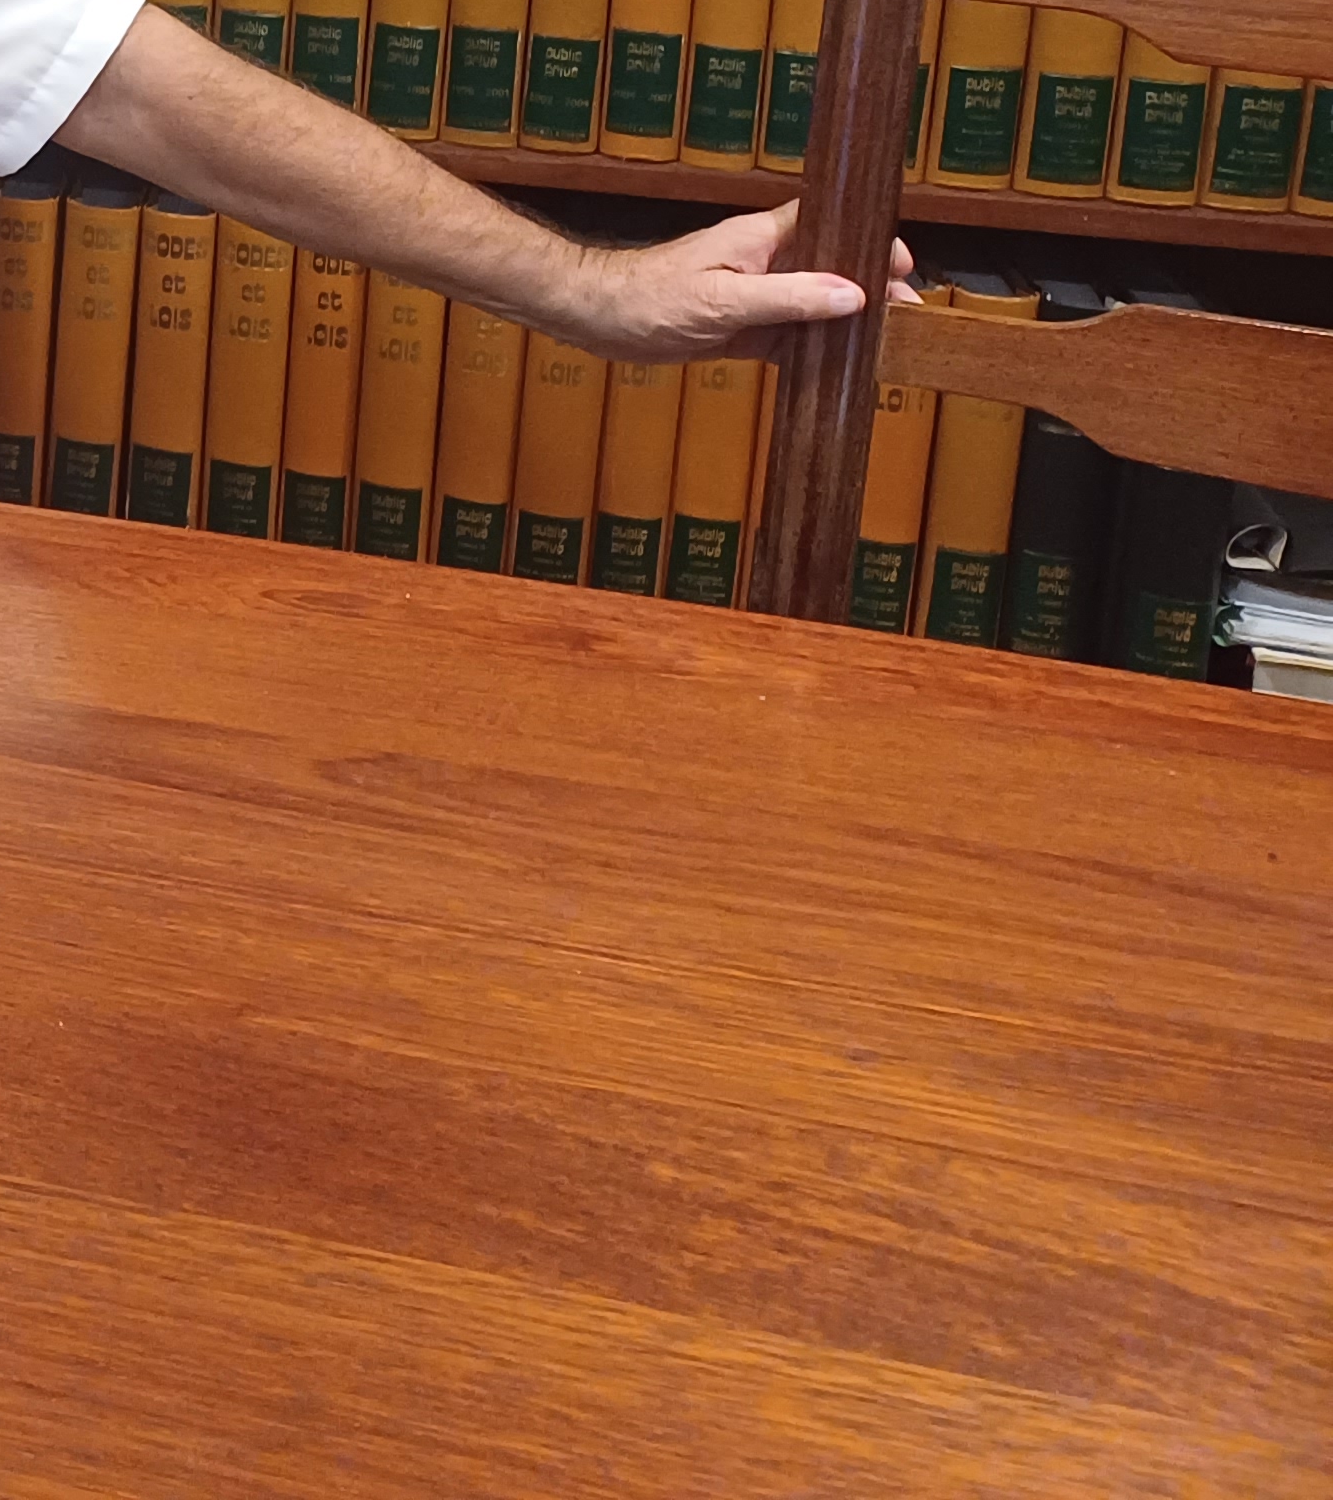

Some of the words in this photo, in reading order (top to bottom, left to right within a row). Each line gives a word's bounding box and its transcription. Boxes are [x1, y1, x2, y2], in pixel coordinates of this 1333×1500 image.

[545, 45, 583, 63] public
[627, 41, 665, 59] public
[708, 56, 746, 74] public
[965, 77, 1005, 92] public
[1055, 85, 1097, 101] public
[1145, 91, 1188, 107] public
[1241, 97, 1284, 114] public
[162, 273, 186, 294] et
[242, 283, 266, 304] et
[318, 291, 343, 312] et
[150, 303, 192, 331] LOIS
